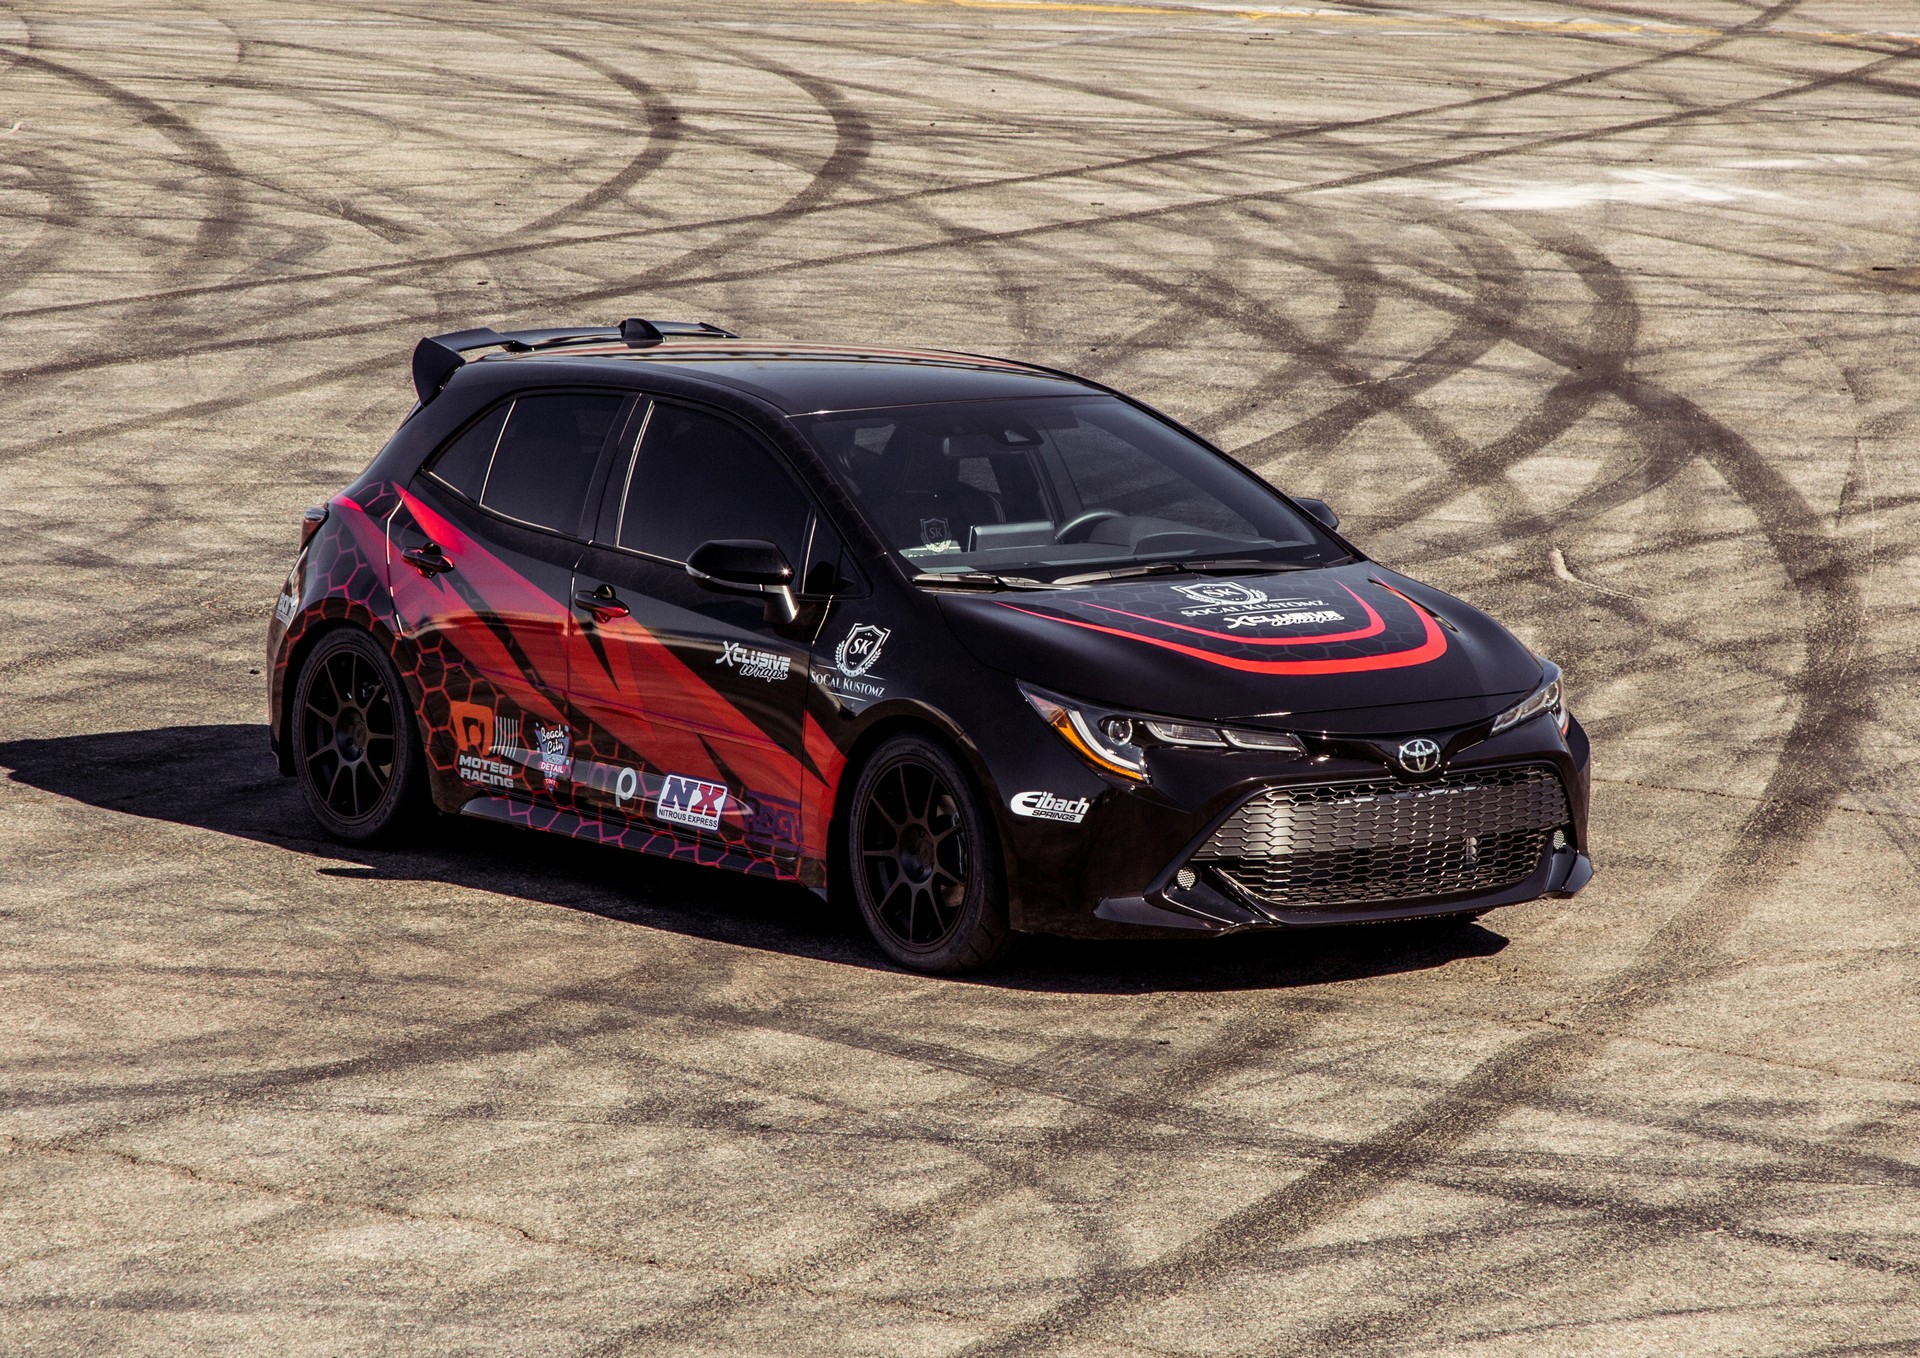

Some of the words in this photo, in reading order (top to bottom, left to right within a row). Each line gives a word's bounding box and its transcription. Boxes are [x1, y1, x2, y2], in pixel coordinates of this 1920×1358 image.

[929, 527, 943, 538] SK
[1203, 588, 1240, 597] SK
[849, 638, 873, 655] SK
[715, 640, 791, 672] XCLUSIVE
[541, 724, 564, 742] Beach
[547, 739, 563, 754] City
[459, 754, 513, 776] MOTEGI
[541, 762, 564, 773] DETAIL
[460, 767, 514, 788] RACING
[661, 777, 726, 818] NX
[1010, 791, 1090, 816] Eibach
[658, 808, 687, 821] NITROUS
[688, 815, 718, 828] EXPRESS
[1032, 810, 1076, 821] SPRINGS
